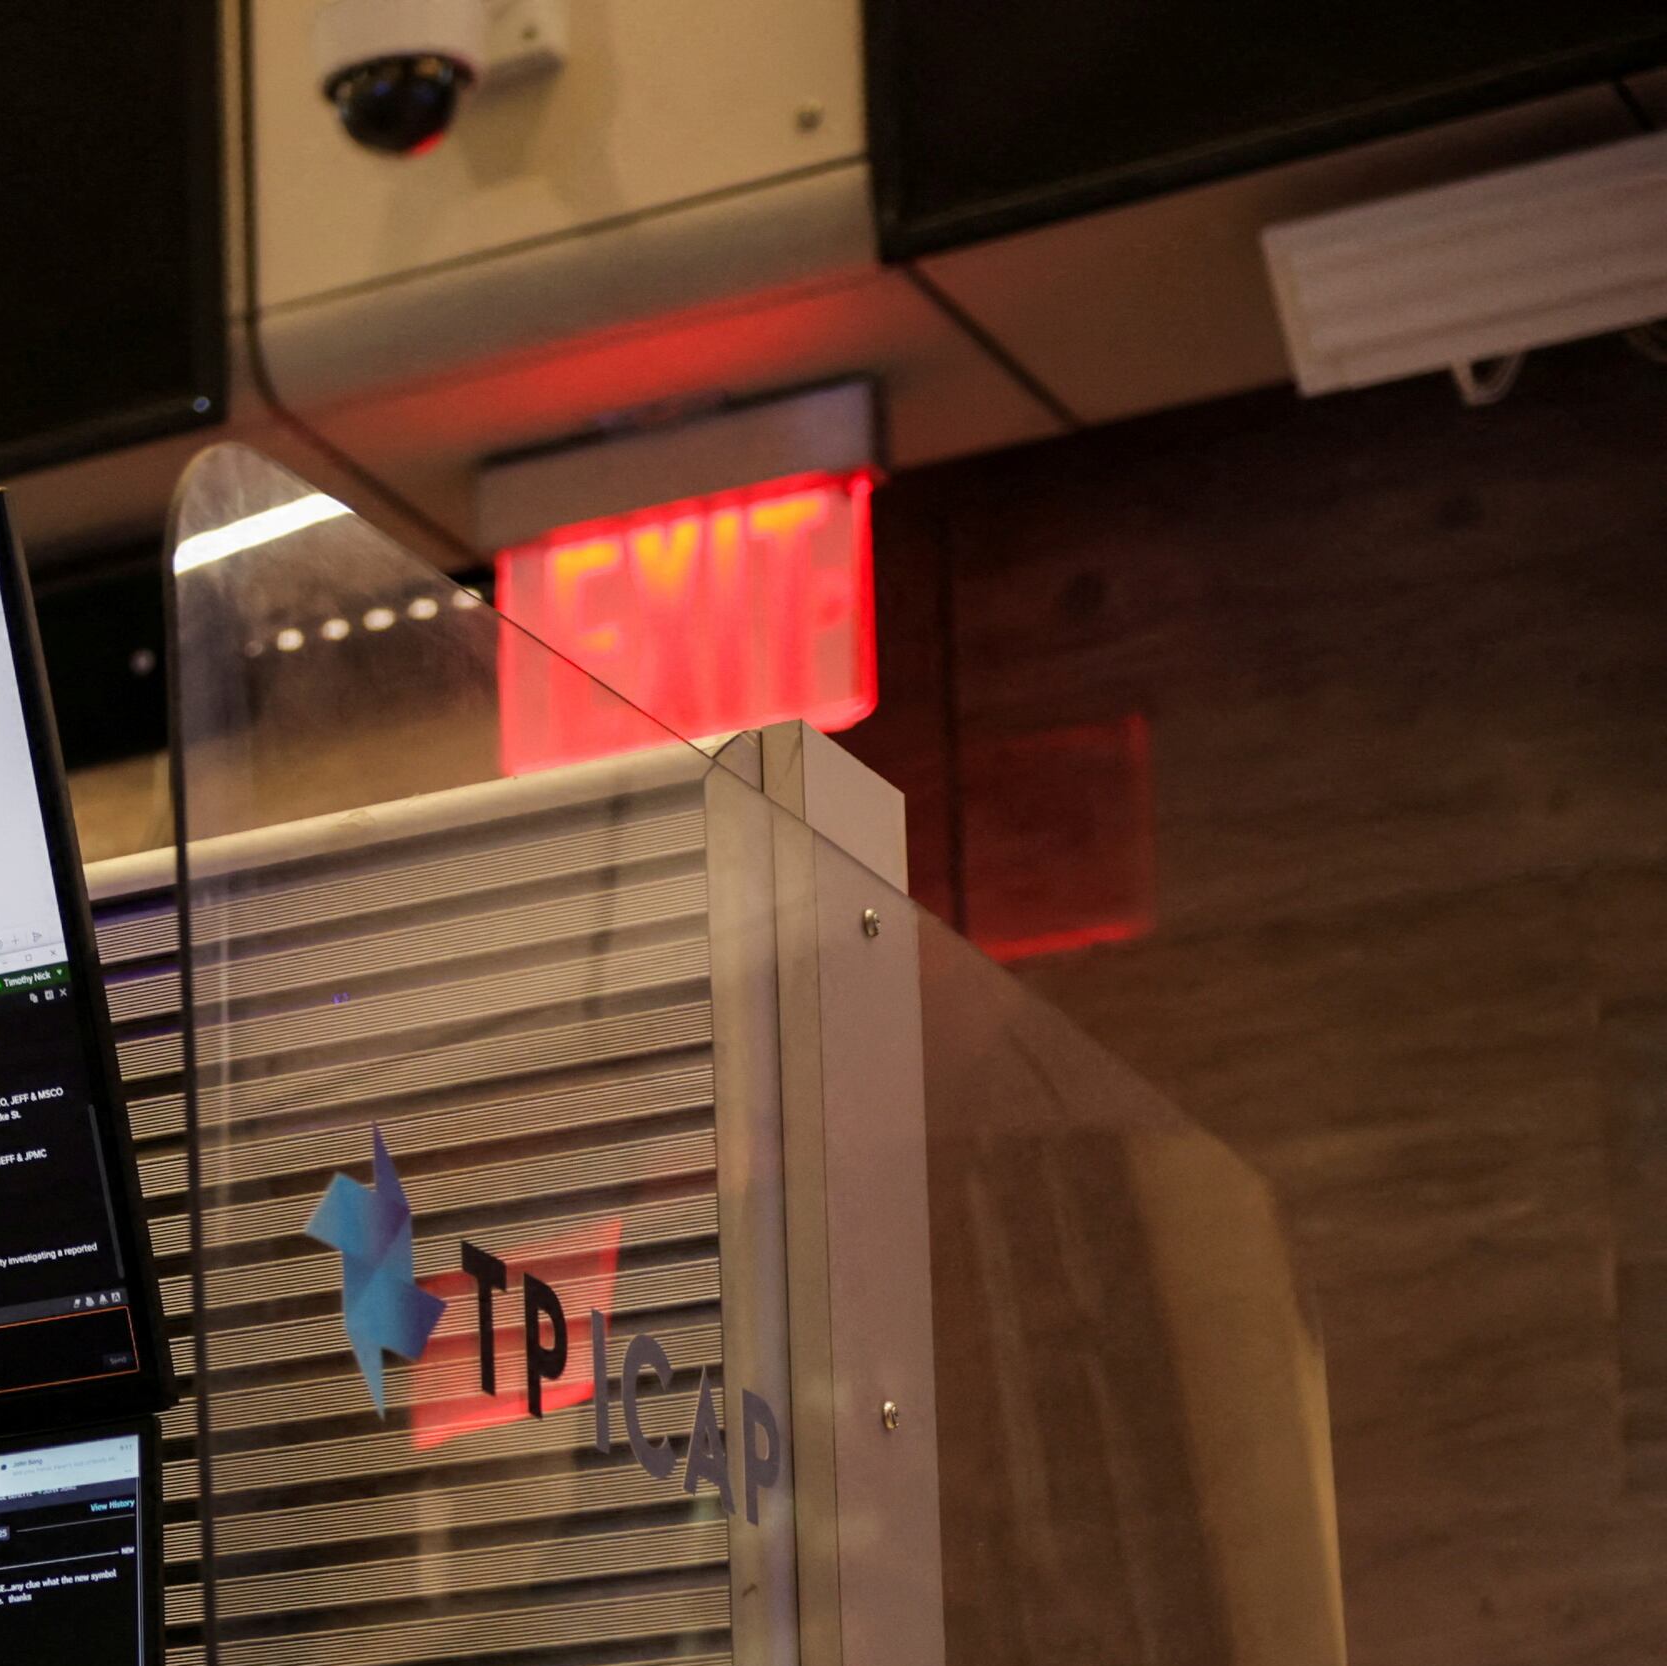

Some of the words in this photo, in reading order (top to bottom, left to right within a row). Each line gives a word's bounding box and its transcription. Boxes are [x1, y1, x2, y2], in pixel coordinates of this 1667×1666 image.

[551, 494, 827, 735] EXIT
[10, 1093, 29, 1105] JEFF
[30, 1091, 37, 1101] &
[37, 1086, 63, 1099] MSCO
[460, 1239, 567, 1419] TP
[591, 1308, 780, 1527] ICAP
[90, 1503, 107, 1511] View
[109, 1499, 135, 1509] History
